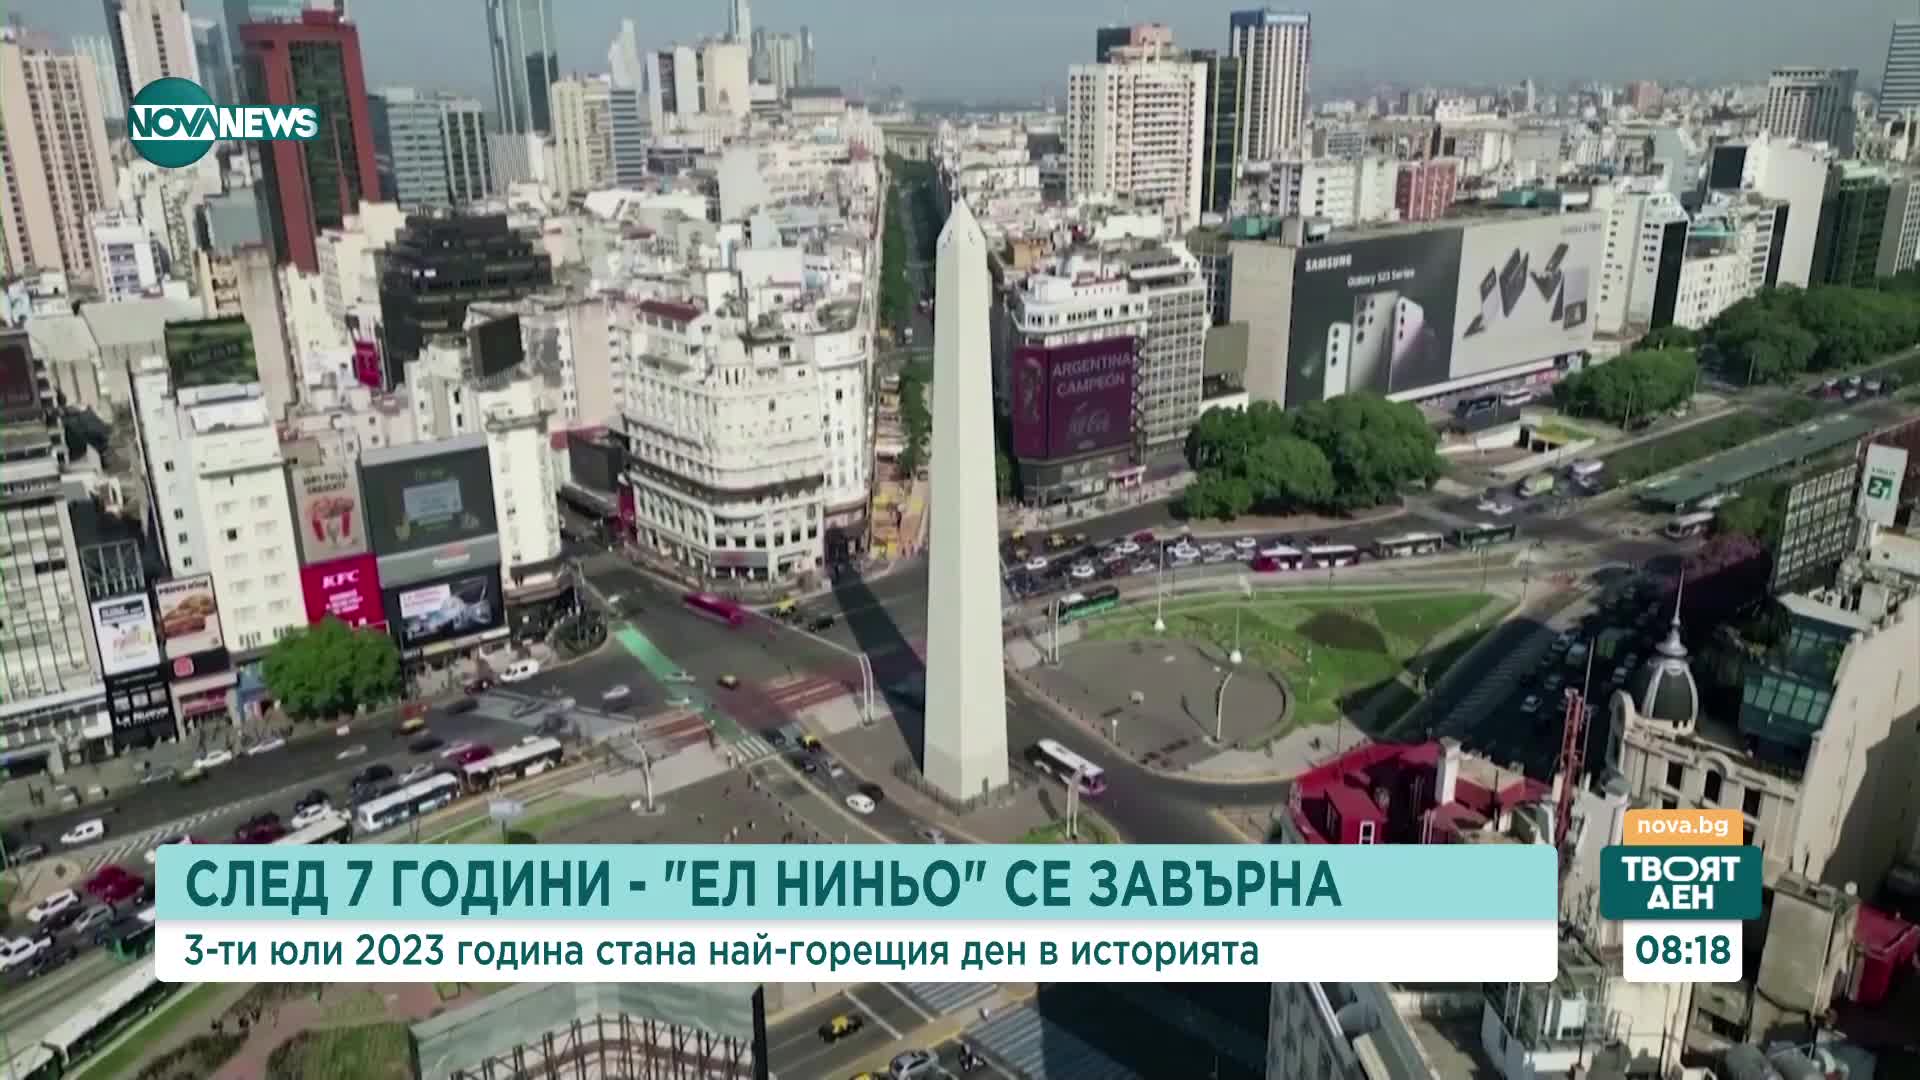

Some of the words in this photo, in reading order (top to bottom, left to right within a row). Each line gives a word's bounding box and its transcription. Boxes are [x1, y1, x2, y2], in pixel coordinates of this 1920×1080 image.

[1305, 254, 1352, 272] SAMSUNG
[1391, 267, 1416, 281] Series
[1052, 352, 1131, 377] ARGENTINA
[322, 570, 360, 588] KFC
